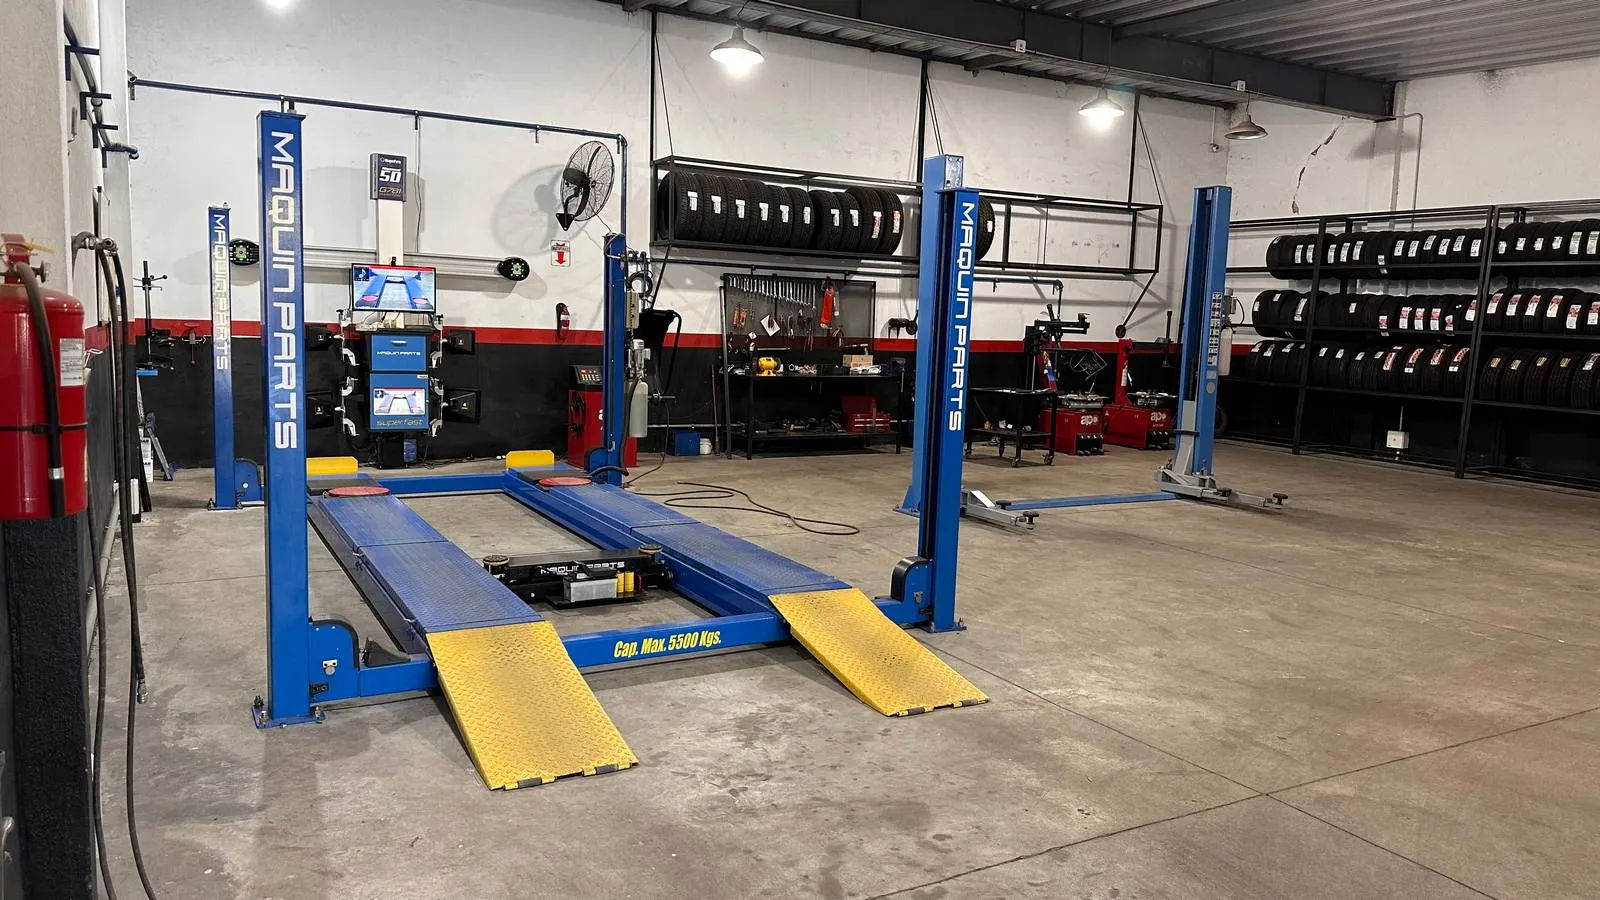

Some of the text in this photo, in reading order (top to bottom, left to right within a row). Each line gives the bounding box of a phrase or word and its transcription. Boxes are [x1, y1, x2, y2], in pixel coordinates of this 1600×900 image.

[213, 214, 229, 370] MAQUIN PARTS
[268, 131, 297, 450] MAQUIN PARTS
[949, 202, 975, 431] MAQUIN PARTS
[613, 630, 722, 658] Cap. Max. 5500 Kgs.
